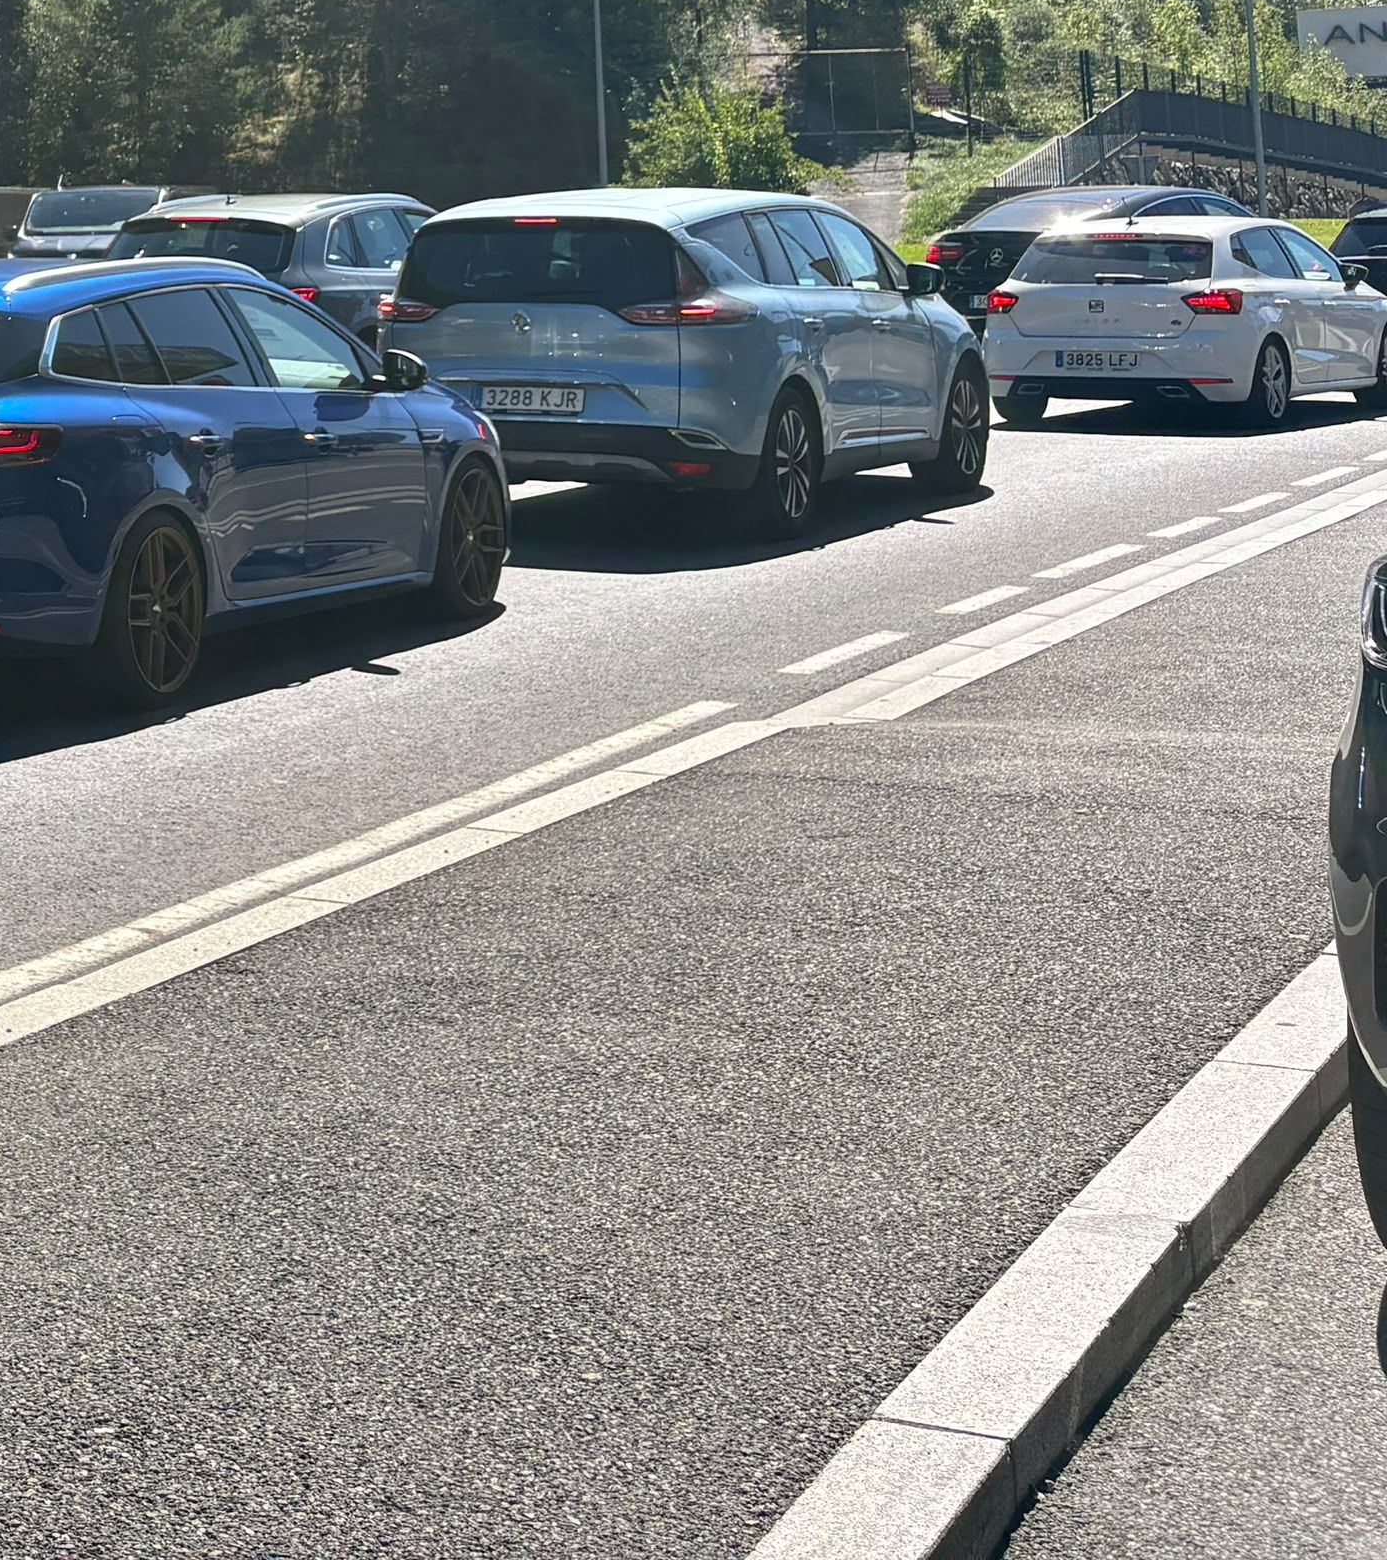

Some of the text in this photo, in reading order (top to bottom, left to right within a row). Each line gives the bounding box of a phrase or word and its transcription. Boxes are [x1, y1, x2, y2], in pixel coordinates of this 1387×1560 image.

[1066, 353, 1138, 367] 3825 LFJ
[486, 389, 579, 409] 3288 KJR
